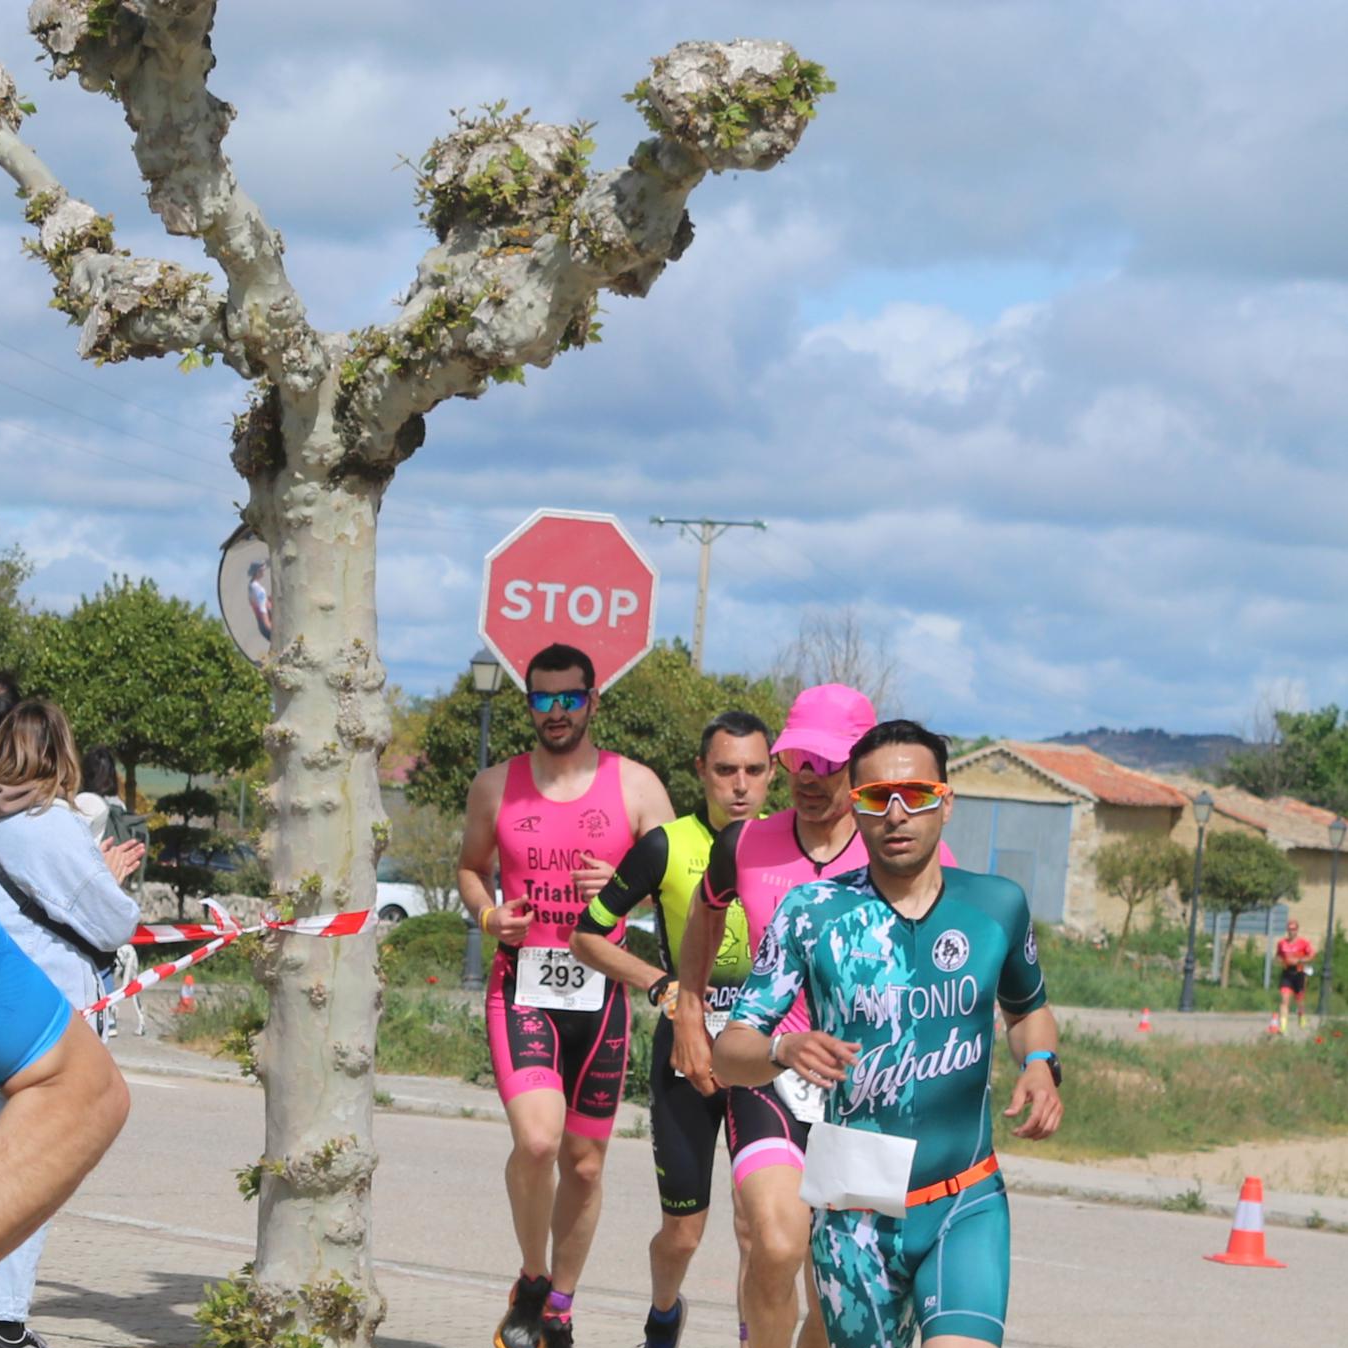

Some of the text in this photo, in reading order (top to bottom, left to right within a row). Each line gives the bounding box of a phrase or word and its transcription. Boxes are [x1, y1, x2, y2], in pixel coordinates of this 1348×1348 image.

[500, 579, 638, 629] STOP
[527, 847, 596, 871] BLANCO
[538, 964, 585, 989] 293
[709, 986, 739, 1008] ADR
[852, 975, 978, 1022] ANTONIO
[838, 1026, 982, 1116] Jabatos
